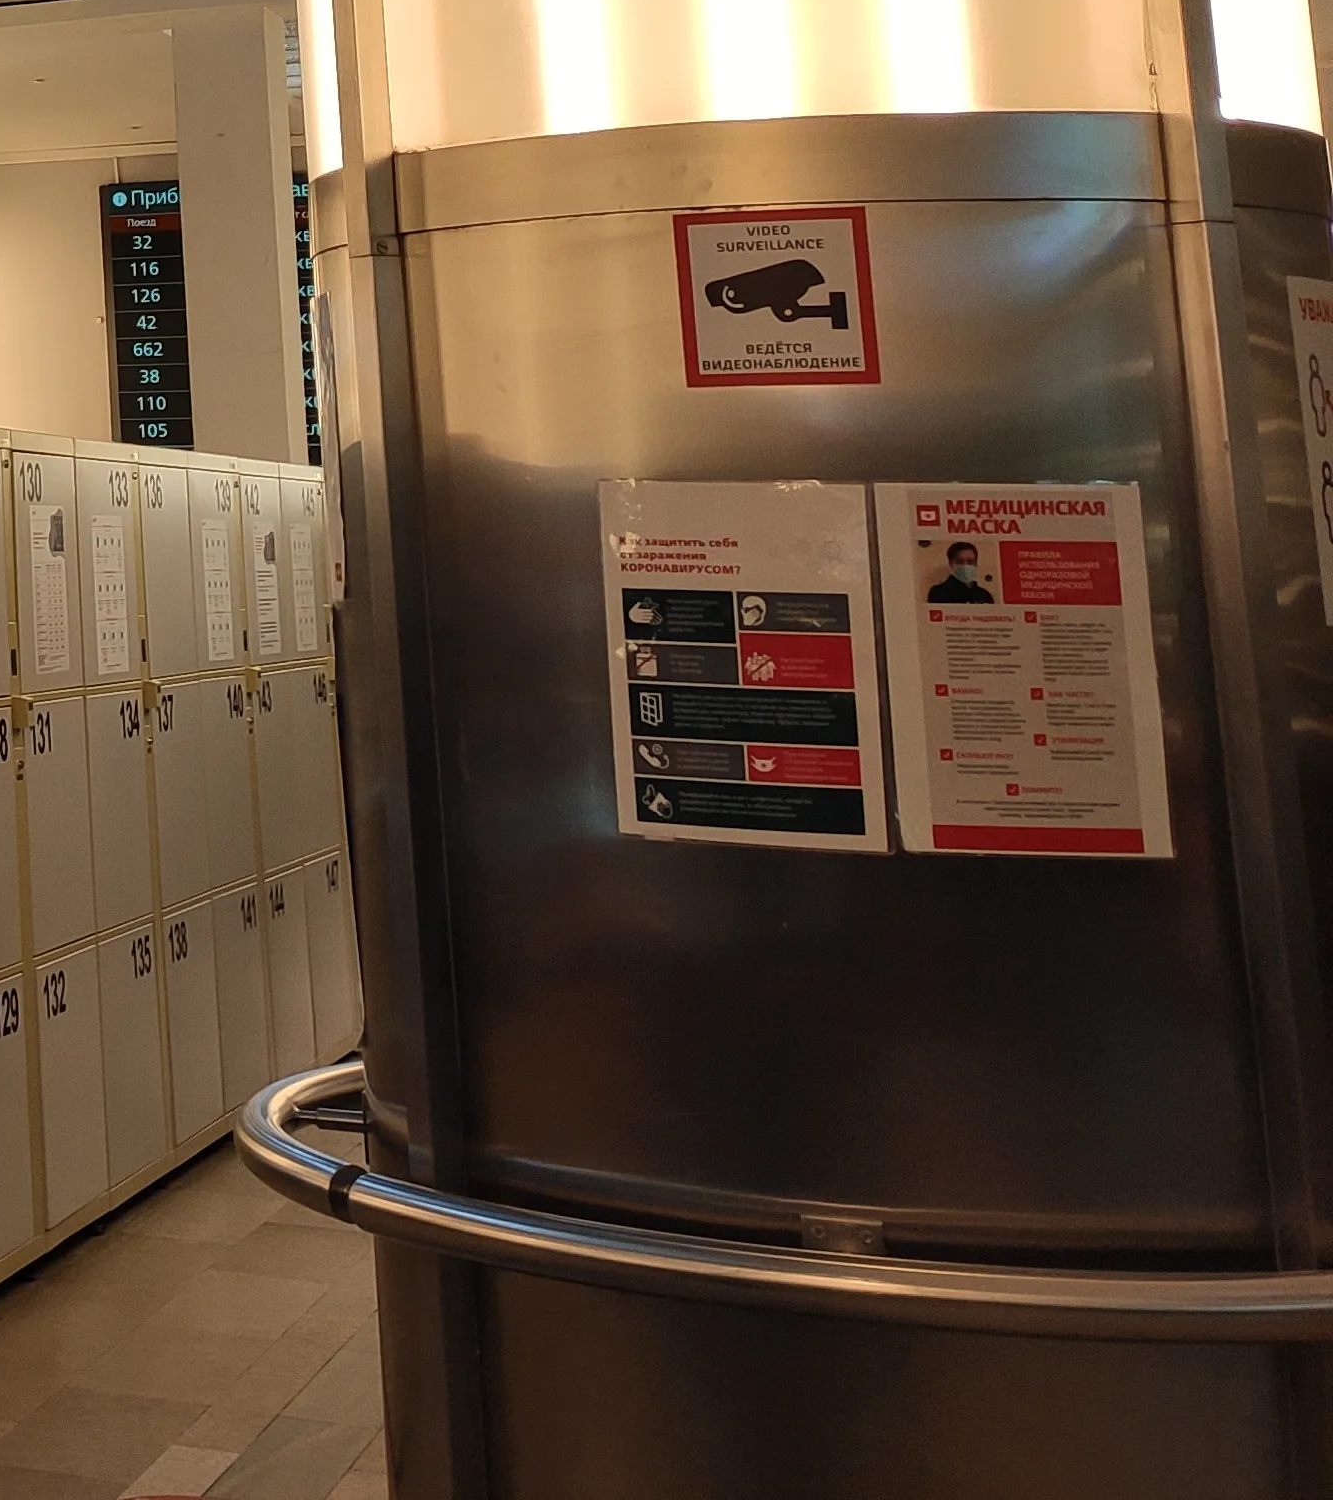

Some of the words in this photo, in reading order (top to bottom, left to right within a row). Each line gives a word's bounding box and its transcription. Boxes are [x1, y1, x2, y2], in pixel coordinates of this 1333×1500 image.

[746, 225, 791, 237] VIDEO
[132, 235, 153, 250] 32
[716, 239, 825, 252] SURVEILLANCE
[129, 261, 159, 277] 116
[131, 288, 161, 304] 126
[136, 315, 157, 330] 42
[133, 342, 164, 357] 662
[745, 341, 812, 355] ВЕДЁТСЯ
[702, 356, 861, 371] ВИДЕОНАБЛЮДЕНИЕ
[139, 369, 160, 384] 38
[137, 396, 167, 411] 110
[138, 423, 168, 438] 105
[19, 460, 43, 503] 130
[108, 469, 130, 508] 133
[144, 473, 164, 509] 136
[214, 479, 232, 513] 139
[244, 483, 261, 516] 142
[945, 499, 1106, 519] МЕДИЦИНСКАЯ
[947, 519, 1021, 534] МАСКА
[645, 538, 705, 548] защитить
[708, 537, 739, 548] себя
[636, 552, 707, 561] заражения
[620, 563, 741, 575] КОРОНАВИРУСОМ?
[226, 682, 245, 719] 140
[119, 698, 141, 740] 134
[269, 881, 285, 919] 144
[240, 892, 258, 931] 141
[168, 920, 188, 964] 138
[130, 934, 152, 980] 135
[43, 969, 67, 1020] 132
